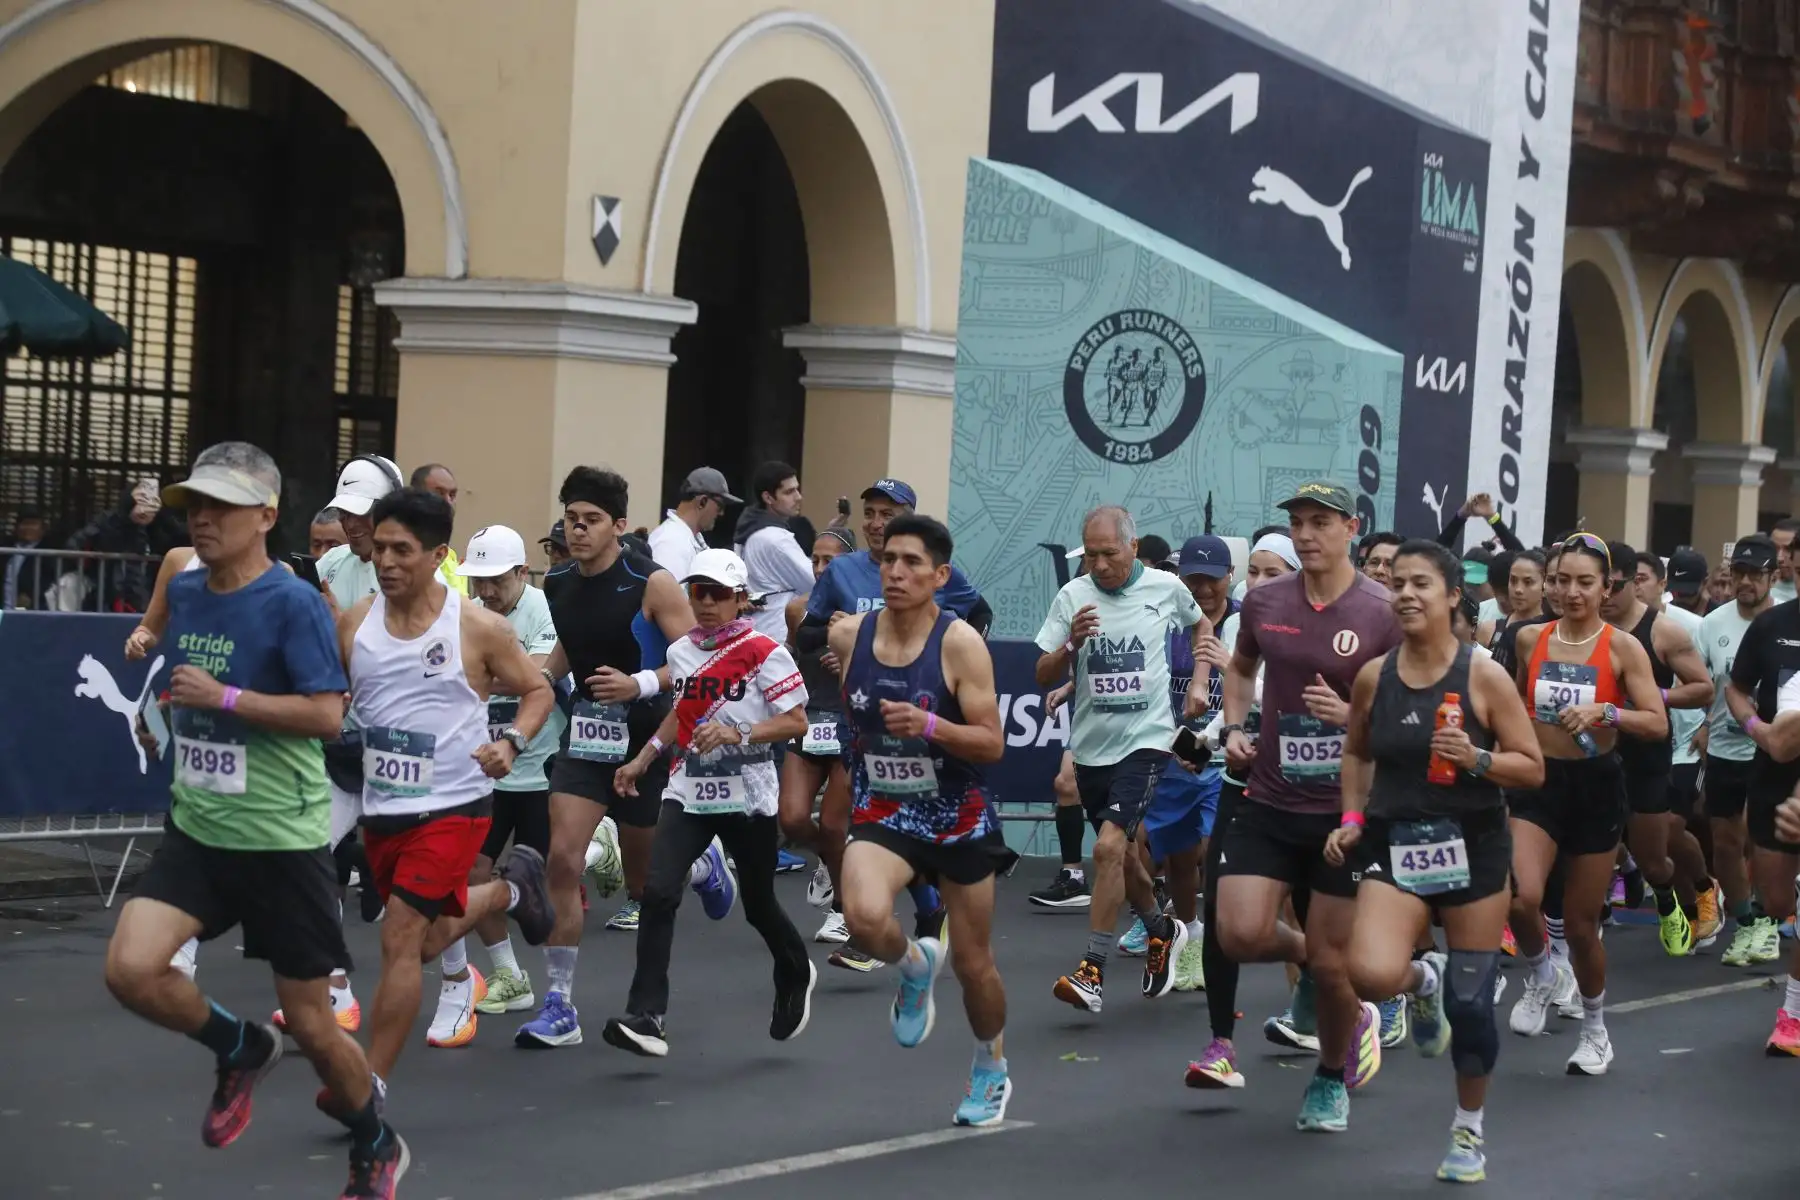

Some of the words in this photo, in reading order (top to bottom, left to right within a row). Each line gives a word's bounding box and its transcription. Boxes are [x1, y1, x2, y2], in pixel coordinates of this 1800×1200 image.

[1027, 72, 1260, 134] KIA
[1423, 152, 1444, 168] KIA
[1421, 167, 1479, 236] LIMA
[1070, 318, 1115, 372] PERU
[1119, 312, 1203, 379] RUNNERS
[1498, 203, 1536, 536] CORAZÓN
[1517, 133, 1541, 181] Y
[1415, 354, 1467, 395] KIA
[1105, 440, 1154, 462] 1984
[178, 633, 234, 655] stride
[1090, 634, 1146, 656] LIMA
[1094, 675, 1141, 694] 5304
[576, 721, 623, 742] 1005
[995, 694, 1071, 747] ISA
[180, 744, 236, 776] 7898
[1287, 740, 1342, 762] 9052
[375, 756, 421, 783] 2011
[874, 760, 925, 780] 9136
[695, 781, 731, 801] 295
[1401, 846, 1457, 871] 4341
